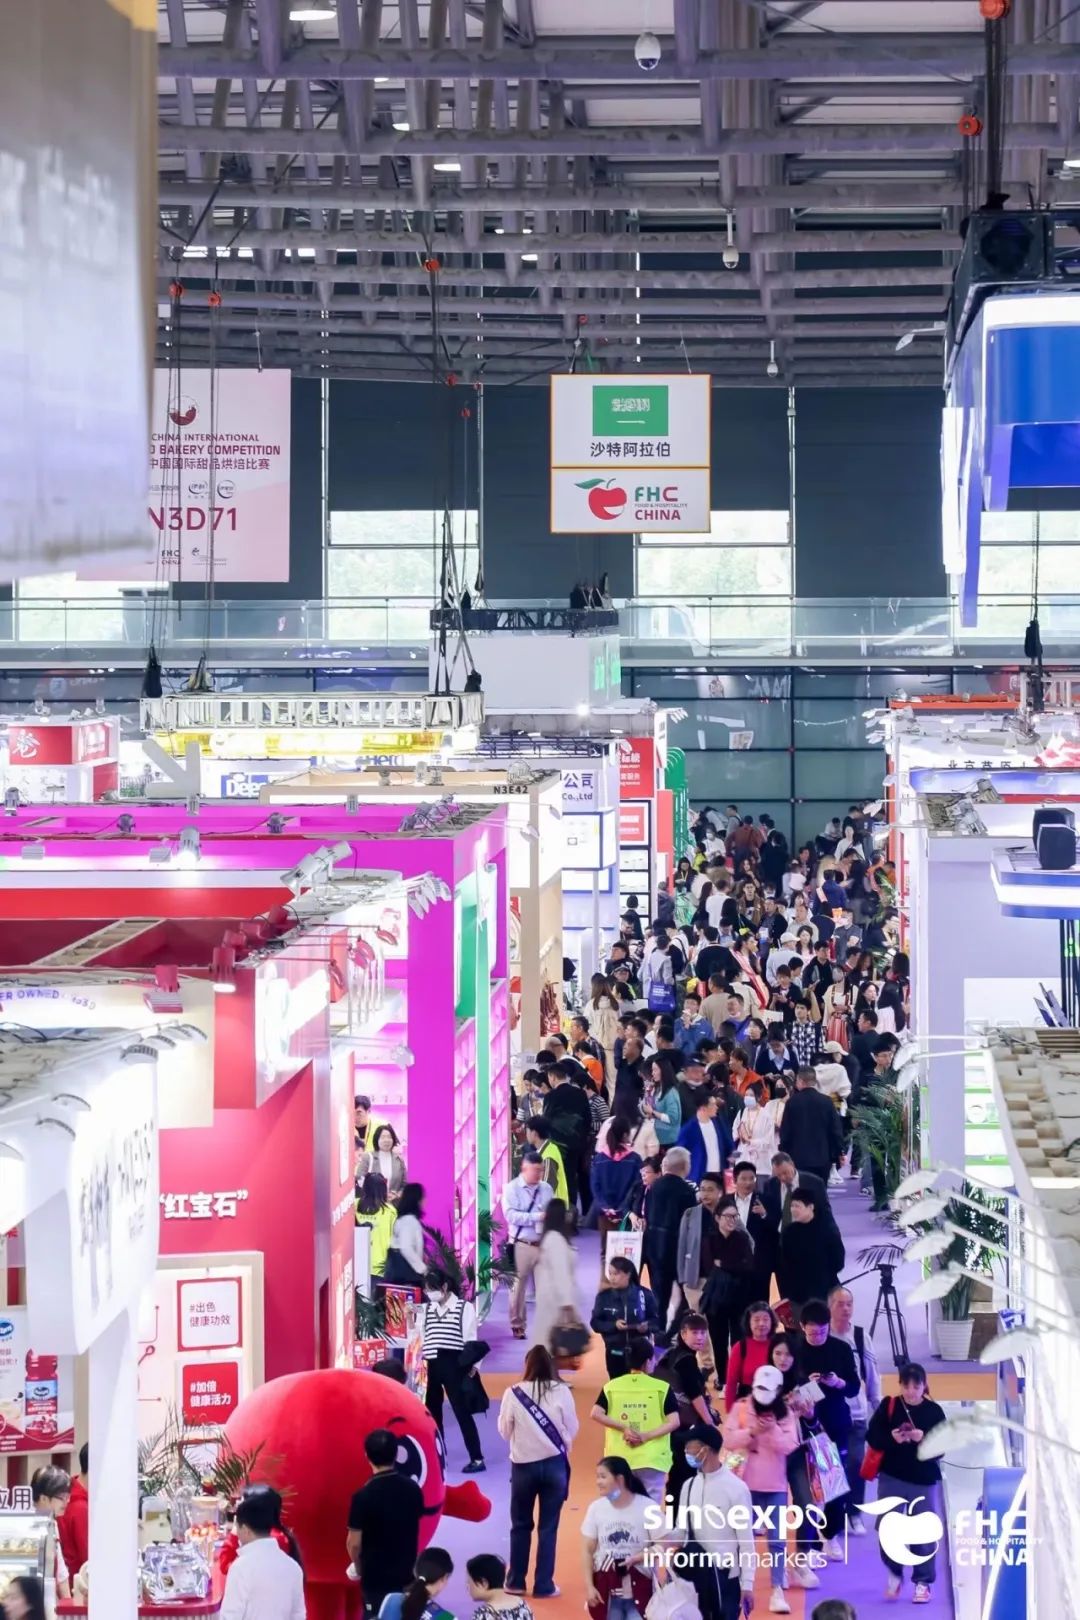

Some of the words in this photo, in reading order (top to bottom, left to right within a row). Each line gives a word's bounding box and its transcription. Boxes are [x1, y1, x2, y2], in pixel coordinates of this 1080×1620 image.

[151, 433, 180, 442] CHINA
[184, 433, 260, 442] INTERNATIONAL
[160, 444, 206, 455] BAKERY
[208, 445, 281, 455] COMPETITION
[590, 442, 671, 458] 沙特阿拉伯
[634, 486, 679, 502] FHC
[634, 509, 681, 521] CHINA
[493, 785, 528, 795] N3E42
[17, 990, 60, 999] OWNED
[189, 1301, 216, 1313] #出色
[189, 1314, 231, 1328] 健康功效
[190, 1380, 217, 1393] #加倍
[190, 1393, 232, 1408] 健康活力
